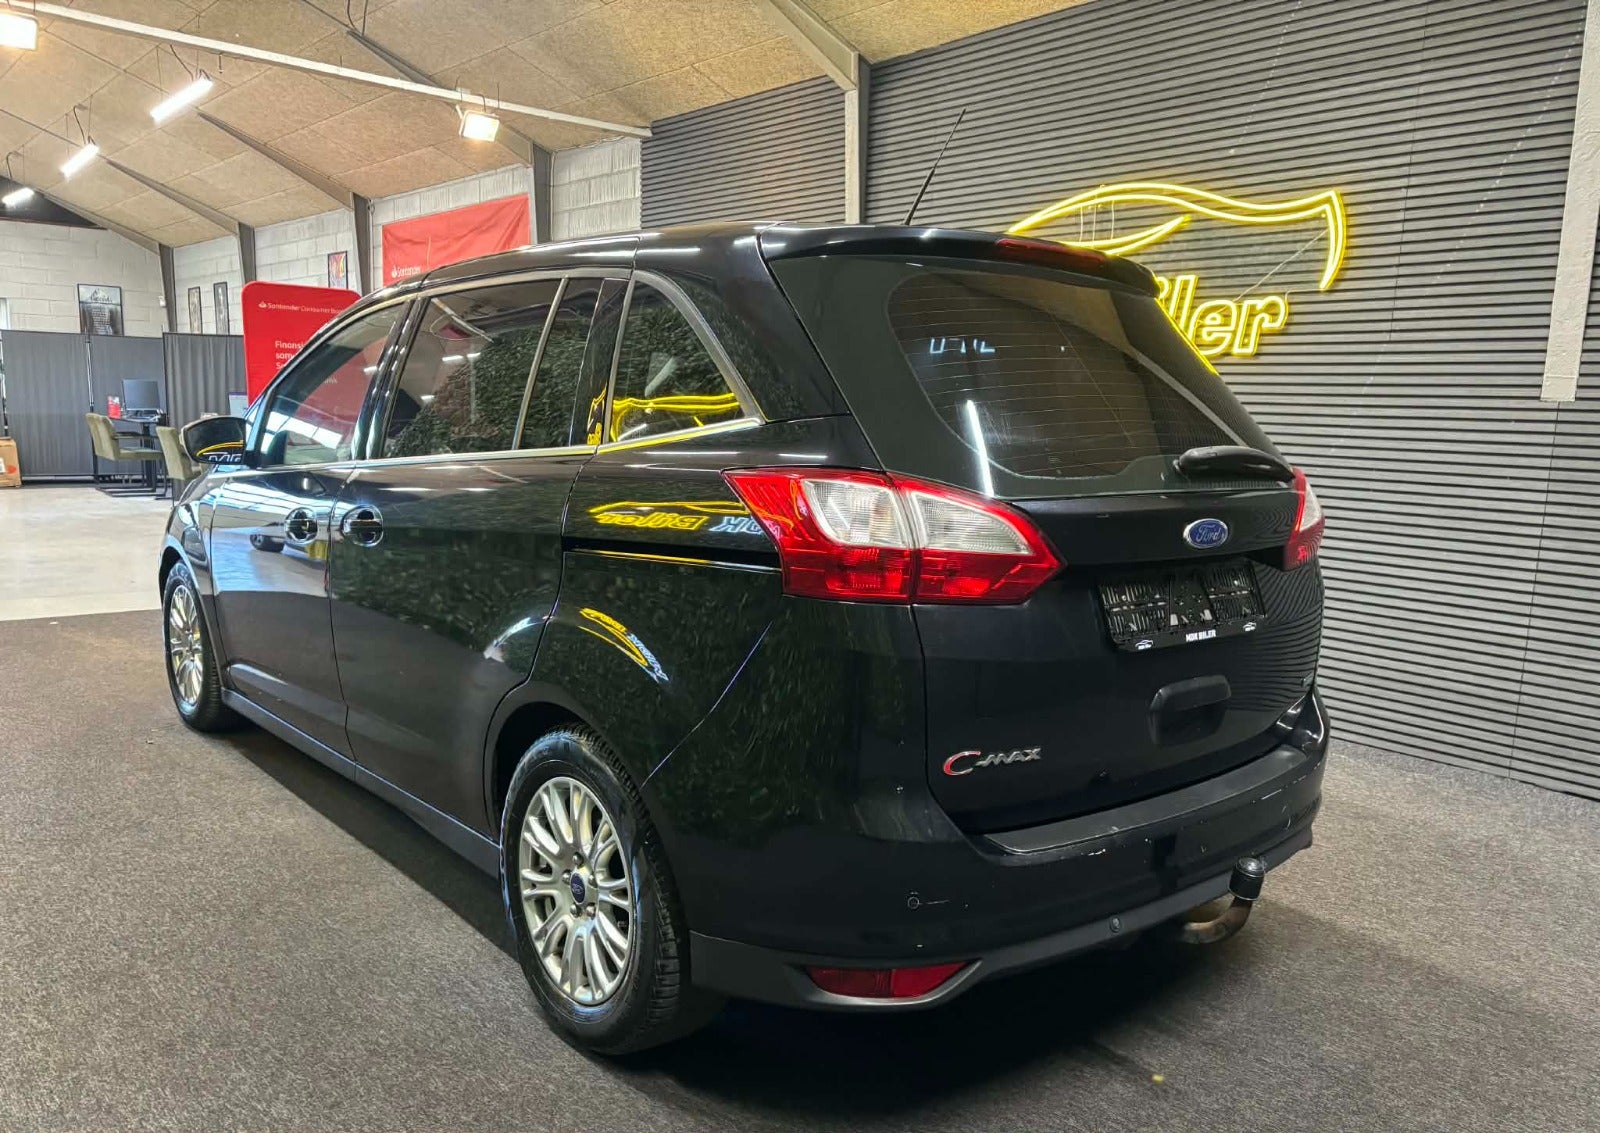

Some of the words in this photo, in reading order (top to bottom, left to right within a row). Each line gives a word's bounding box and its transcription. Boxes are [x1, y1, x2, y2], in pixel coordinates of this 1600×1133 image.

[267, 302, 299, 311] Santander
[1157, 274, 1288, 357] ler
[1195, 524, 1222, 542] Ford
